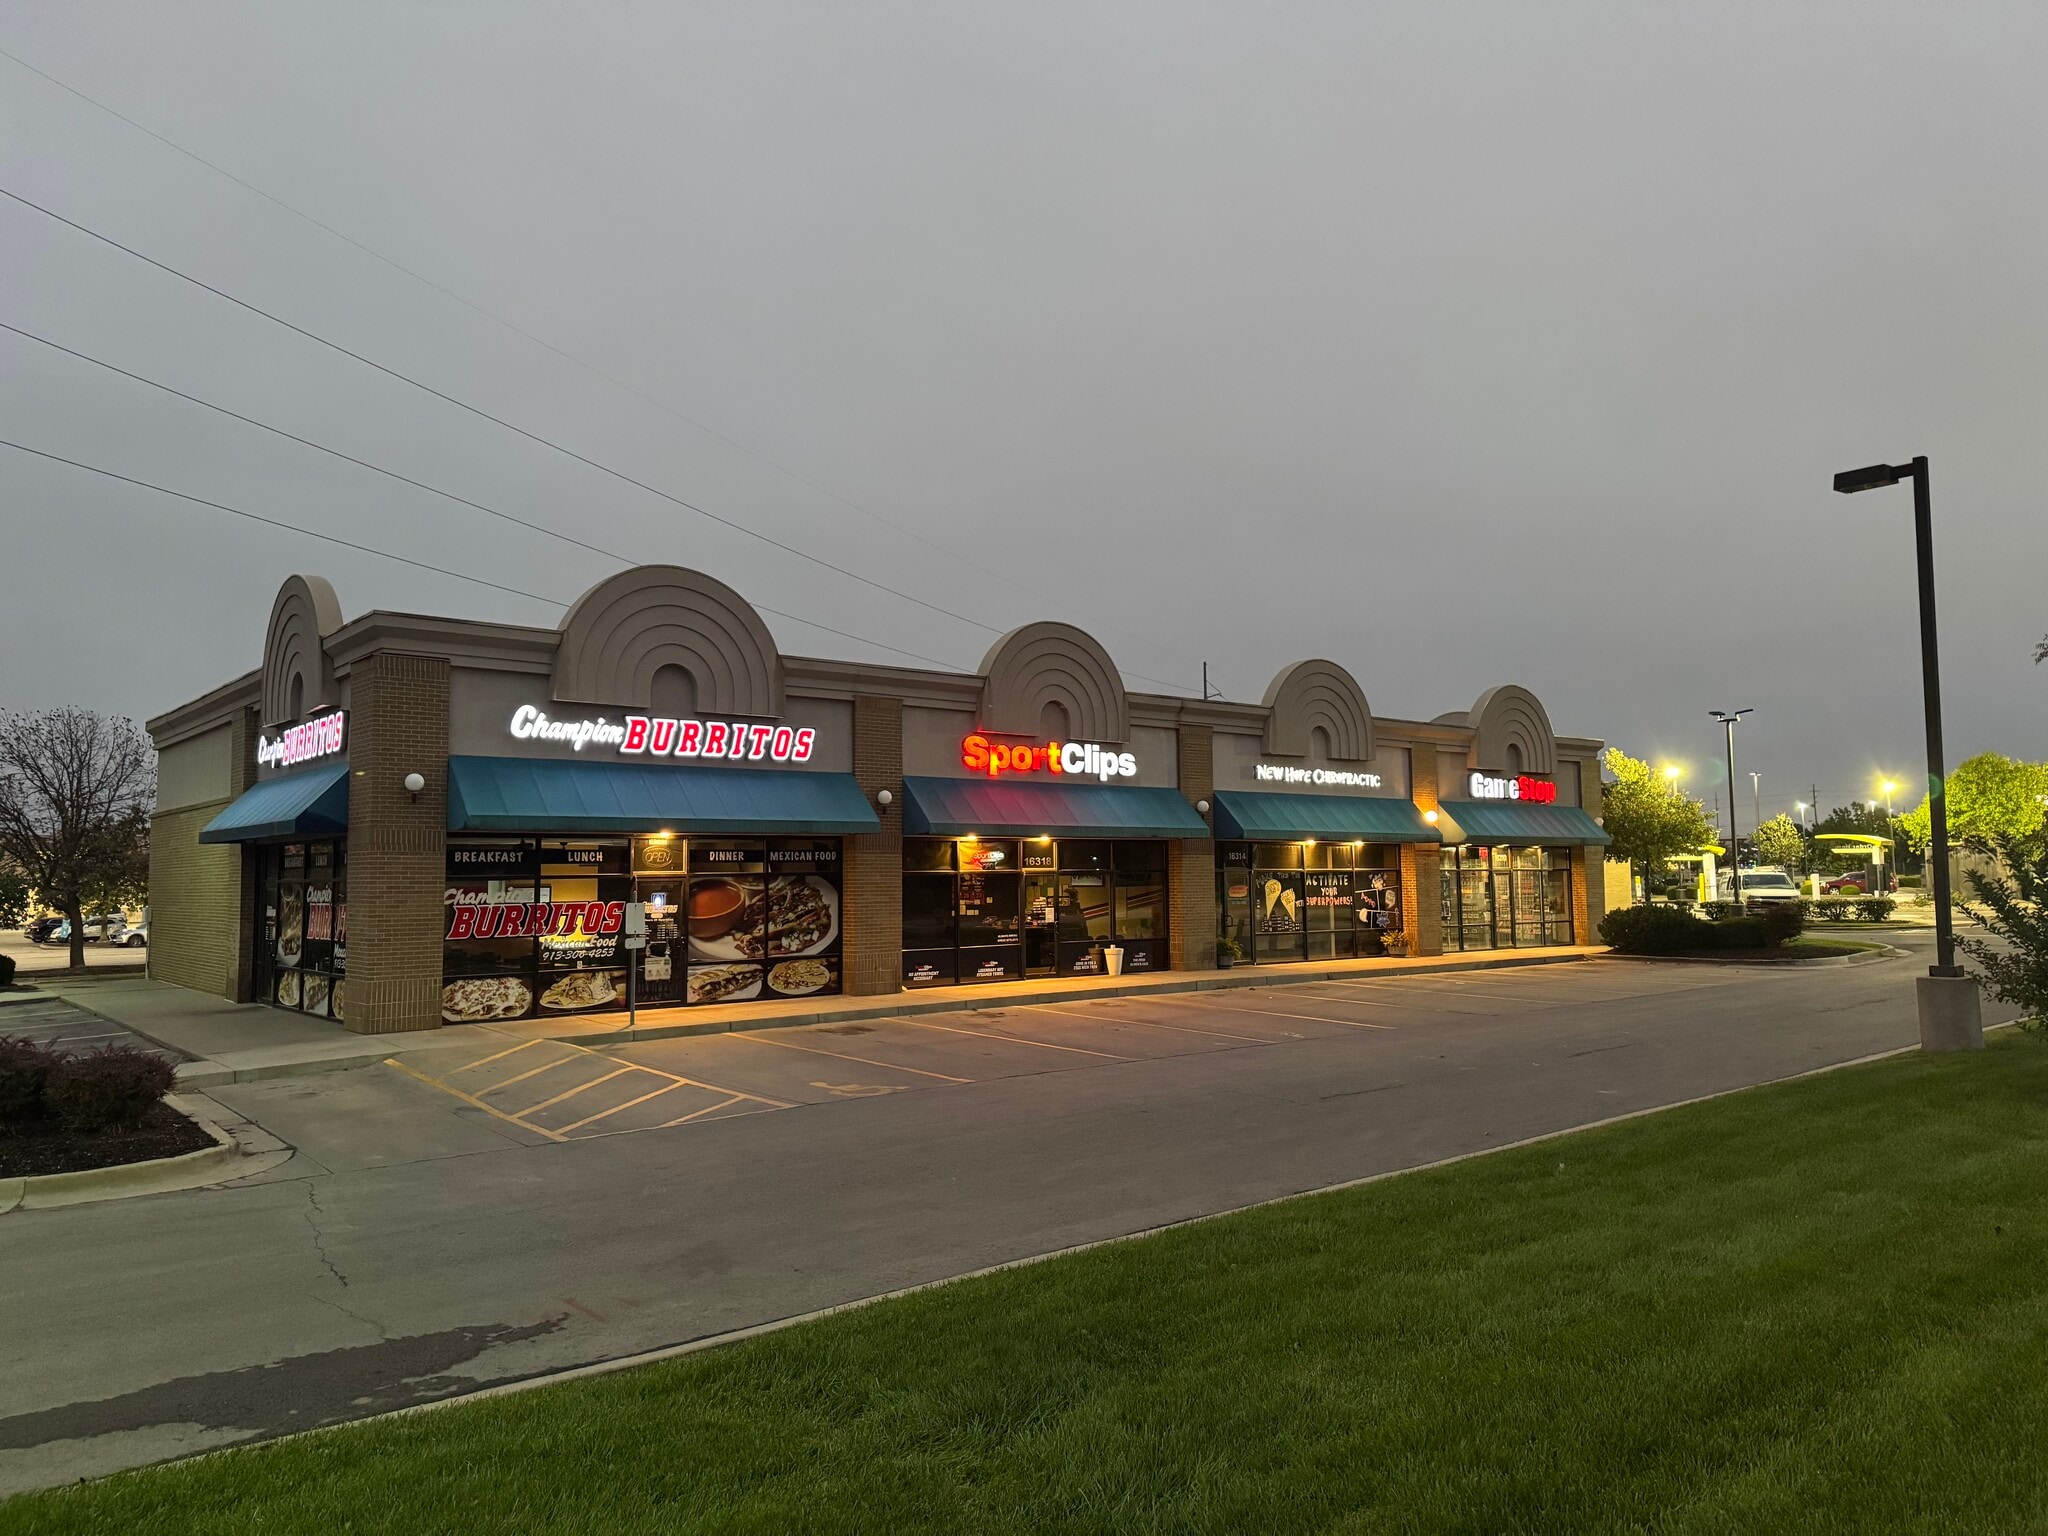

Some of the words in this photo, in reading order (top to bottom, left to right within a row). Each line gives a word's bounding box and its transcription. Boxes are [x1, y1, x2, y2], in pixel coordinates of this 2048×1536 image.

[510, 704, 624, 750] Champion
[620, 716, 815, 761] BURRITOS
[282, 711, 343, 766] BURRITOS
[963, 735, 1137, 782] SportClips
[1470, 772, 1557, 805] GameStop
[455, 852, 524, 862] BREAKFAST
[568, 852, 603, 862] LUNCH
[709, 851, 745, 861] DINNER
[770, 851, 812, 861] MEXICAN
[814, 851, 837, 861] FOOD
[1025, 857, 1052, 865] 16318
[1305, 874, 1349, 886] ACTIVATE
[1320, 887, 1338, 896] YOUR
[1306, 896, 1353, 906] SUPERPOWERS!
[445, 901, 626, 940] BURRITOS
[589, 935, 618, 947] Food
